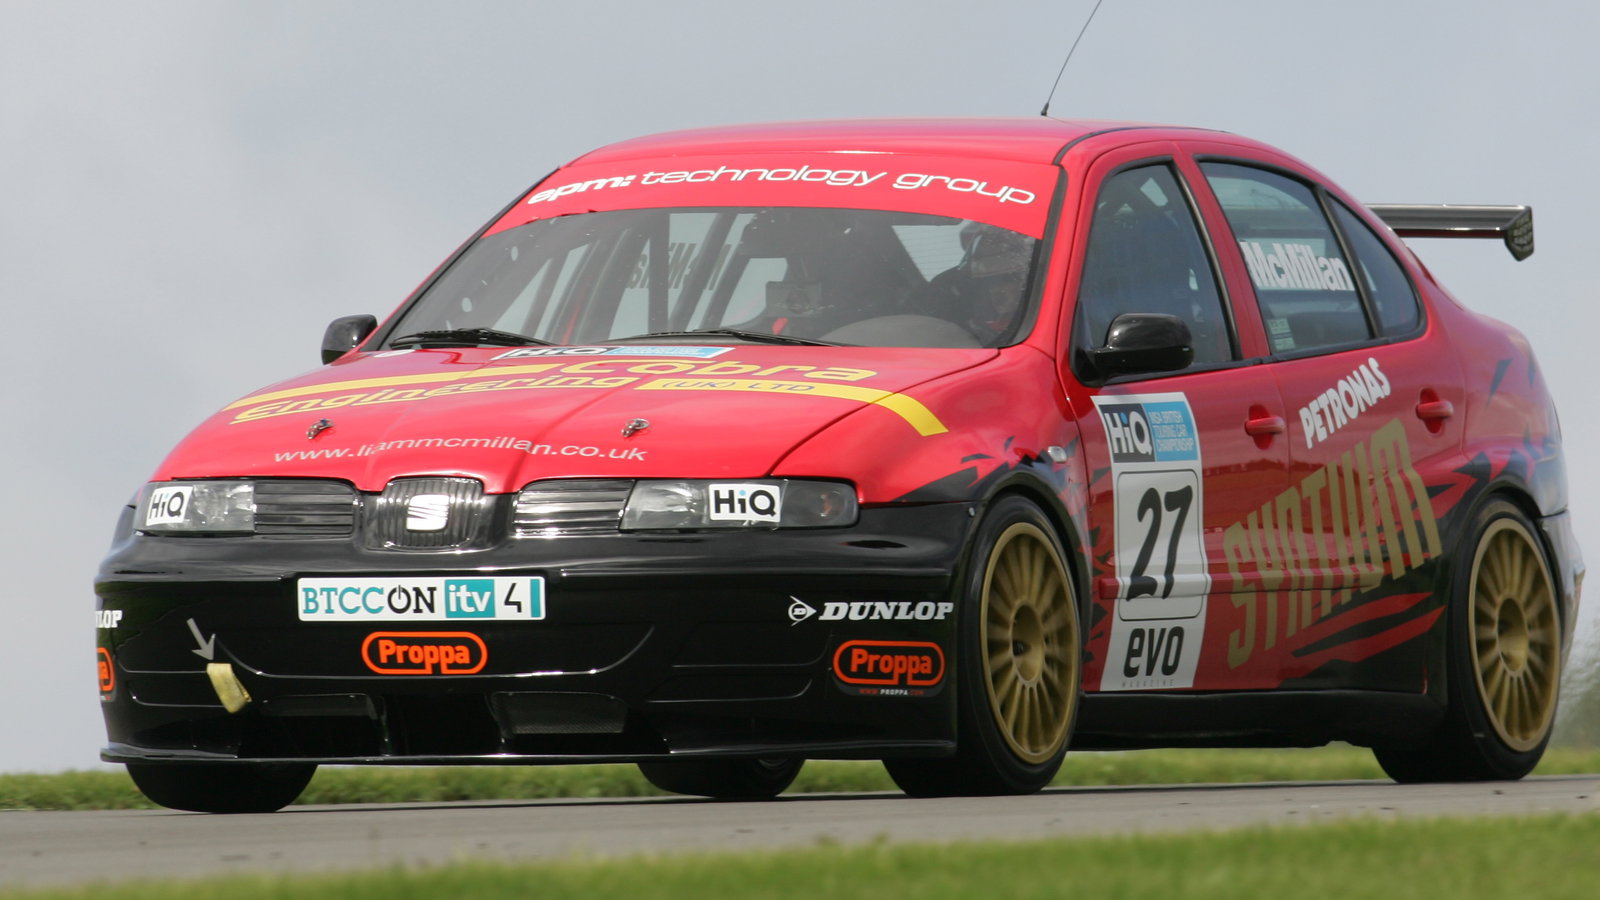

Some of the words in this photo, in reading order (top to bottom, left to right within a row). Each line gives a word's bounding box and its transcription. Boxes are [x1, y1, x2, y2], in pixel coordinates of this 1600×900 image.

[640, 165, 888, 187] technology
[892, 173, 1035, 204] group
[1239, 241, 1355, 291] McMillan
[560, 359, 877, 381] Cobra
[747, 382, 816, 391] LTD
[1299, 357, 1391, 449] PETRONAS
[274, 436, 648, 462] www.liammcmillan.co.uk
[1104, 411, 1152, 454] HiQ
[149, 491, 184, 520] HiQ
[714, 489, 777, 516] HiQ
[1126, 485, 1193, 602] 27
[1223, 418, 1442, 670] SYNTIUM
[818, 601, 954, 620] DUNLOP
[378, 639, 471, 674] Proppa
[850, 648, 933, 685] Proppa
[1123, 625, 1185, 678] evo
